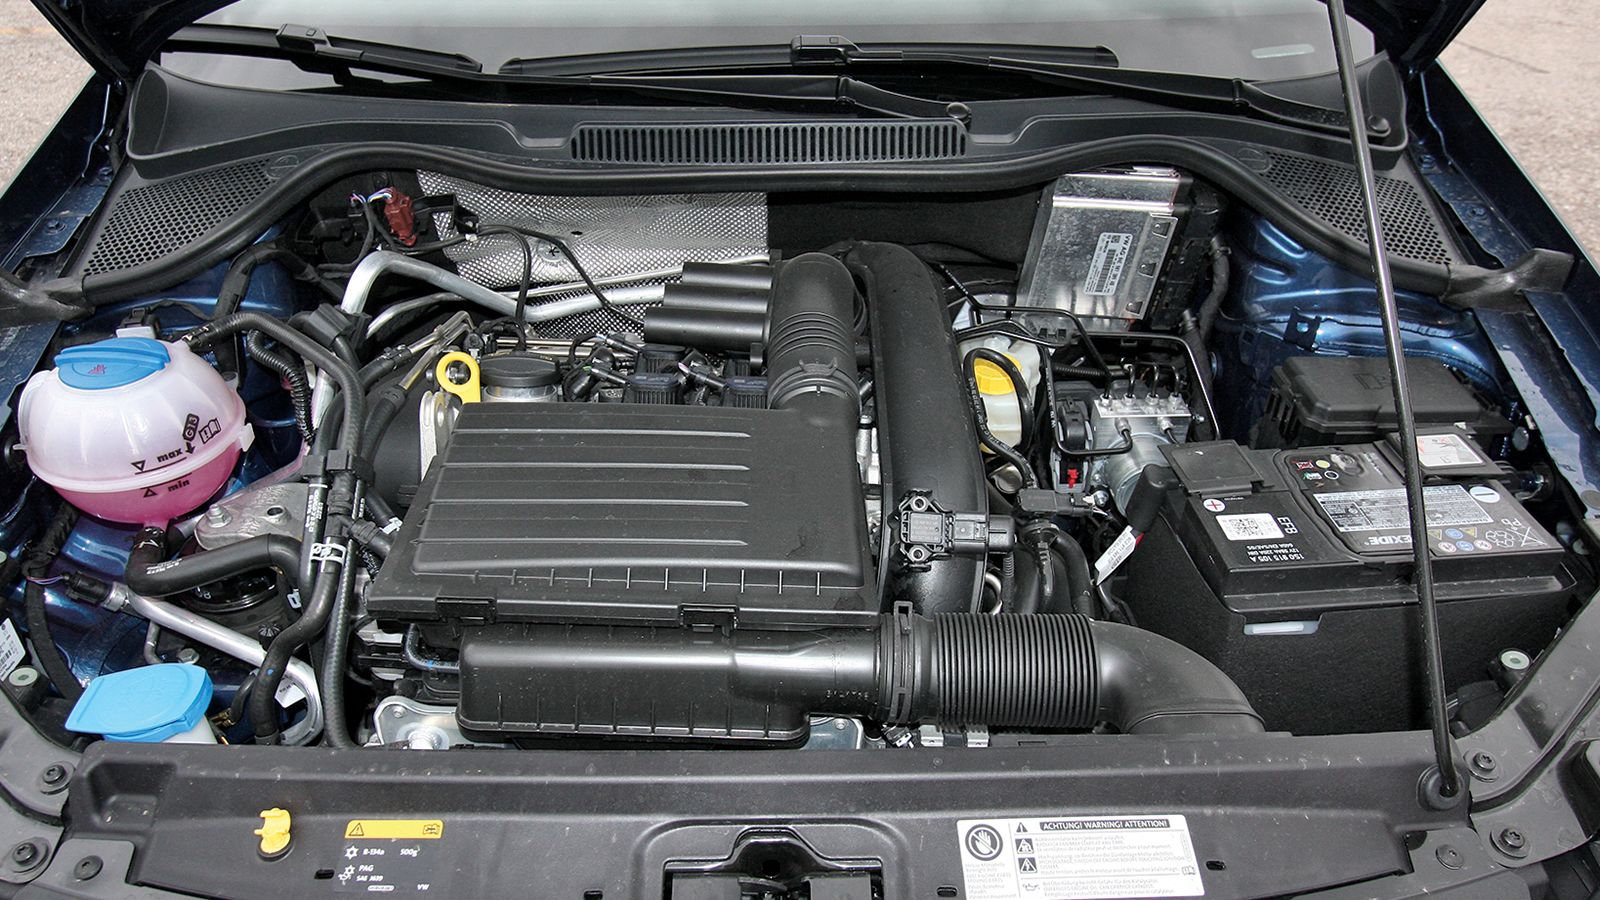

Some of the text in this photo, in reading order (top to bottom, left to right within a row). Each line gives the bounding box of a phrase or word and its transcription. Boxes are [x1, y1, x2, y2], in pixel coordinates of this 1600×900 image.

[185, 417, 198, 438] G13
[157, 448, 183, 462] max
[168, 480, 190, 492] min
[1277, 516, 1298, 534] EFB
[1502, 518, 1521, 528] Pb
[1368, 534, 1412, 545] EXIDE
[1043, 820, 1168, 831] ACHTUNG! WARNING! ATTENTION!
